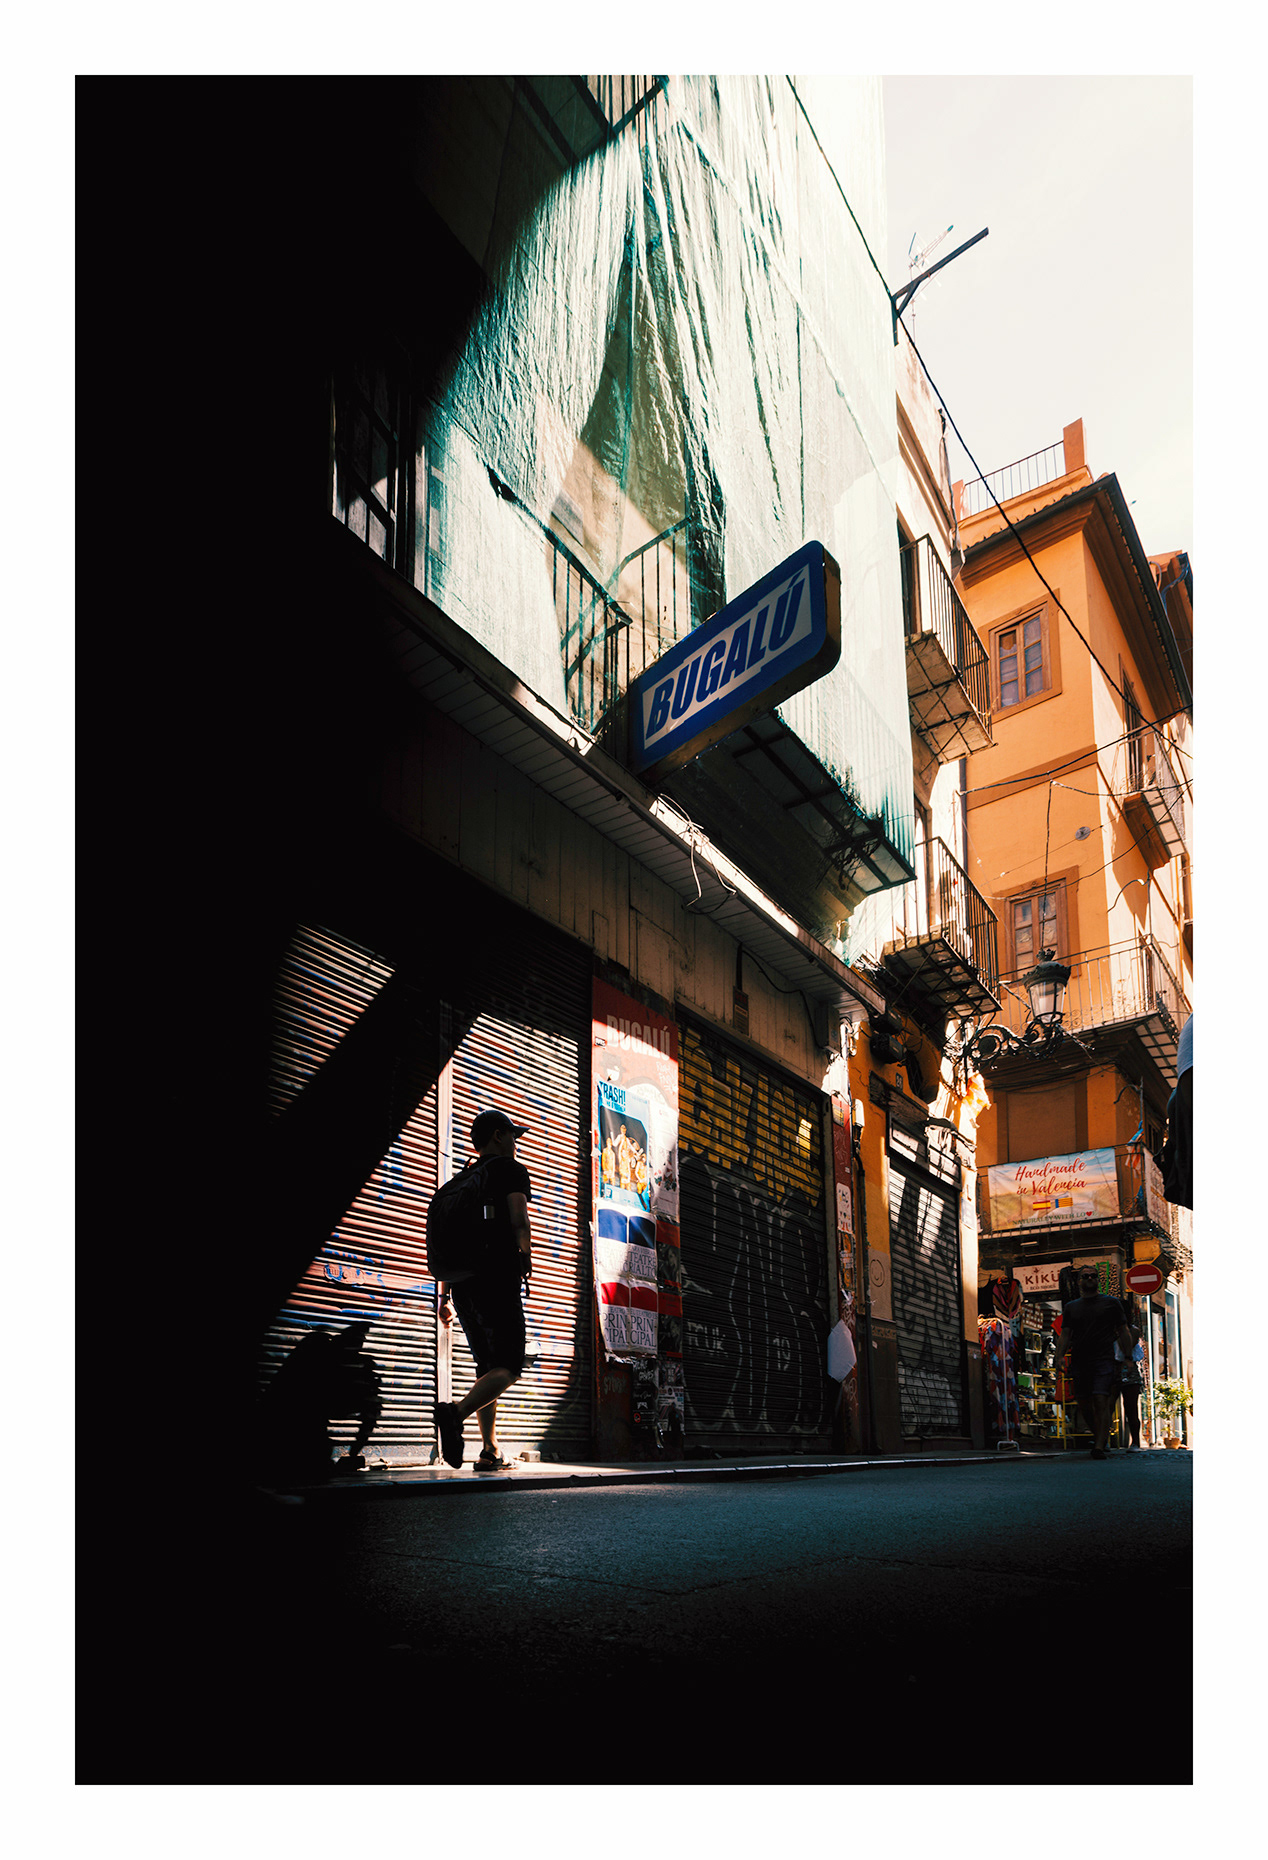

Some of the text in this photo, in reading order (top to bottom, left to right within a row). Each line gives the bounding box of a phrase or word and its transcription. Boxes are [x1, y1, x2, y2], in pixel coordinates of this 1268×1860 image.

[646, 572, 805, 740] BUGALÚ
[606, 1014, 671, 1061] BUGALÚ
[598, 1080, 627, 1106] TRASH!
[1015, 1158, 1087, 1181] Handmade
[1016, 1176, 1087, 1195] in Valencia
[628, 1251, 657, 1267] TEATRE
[629, 1261, 657, 1278] RIALTO
[630, 1330, 656, 1348] CIPAL
